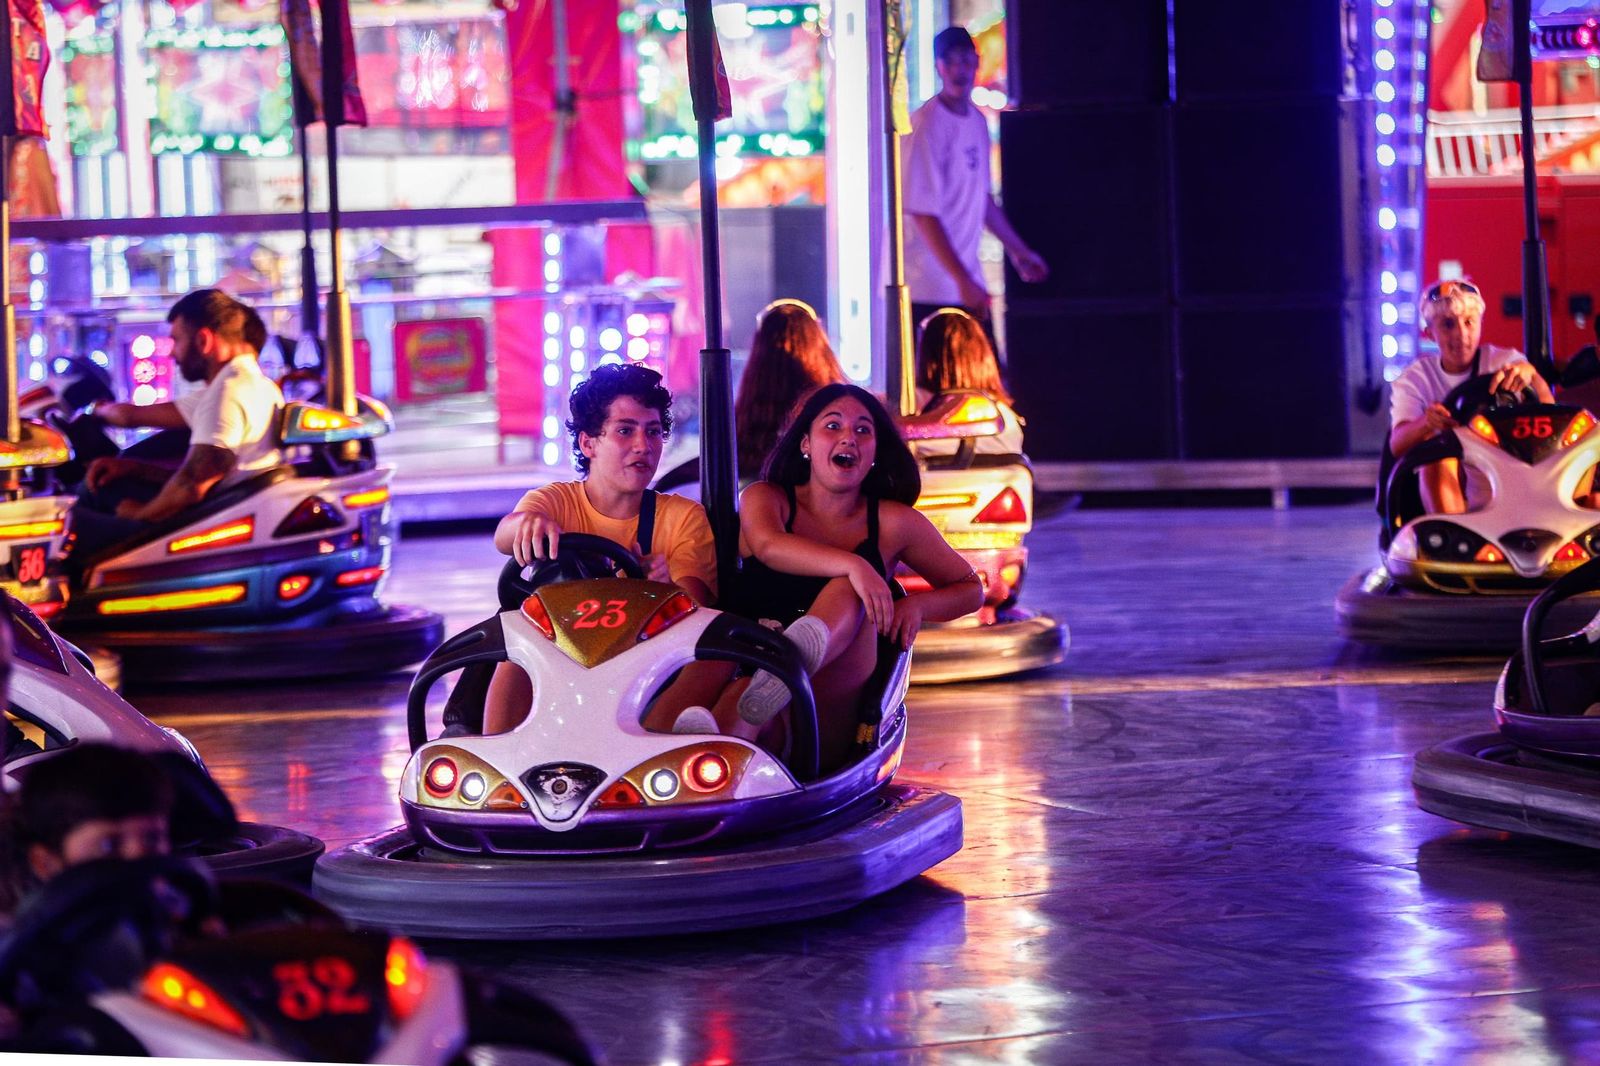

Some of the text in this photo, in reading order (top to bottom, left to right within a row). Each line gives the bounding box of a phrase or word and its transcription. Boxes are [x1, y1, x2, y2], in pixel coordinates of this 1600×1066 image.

[1512, 416, 1553, 439] 35
[573, 599, 628, 629] 23
[273, 957, 369, 1020] 32
